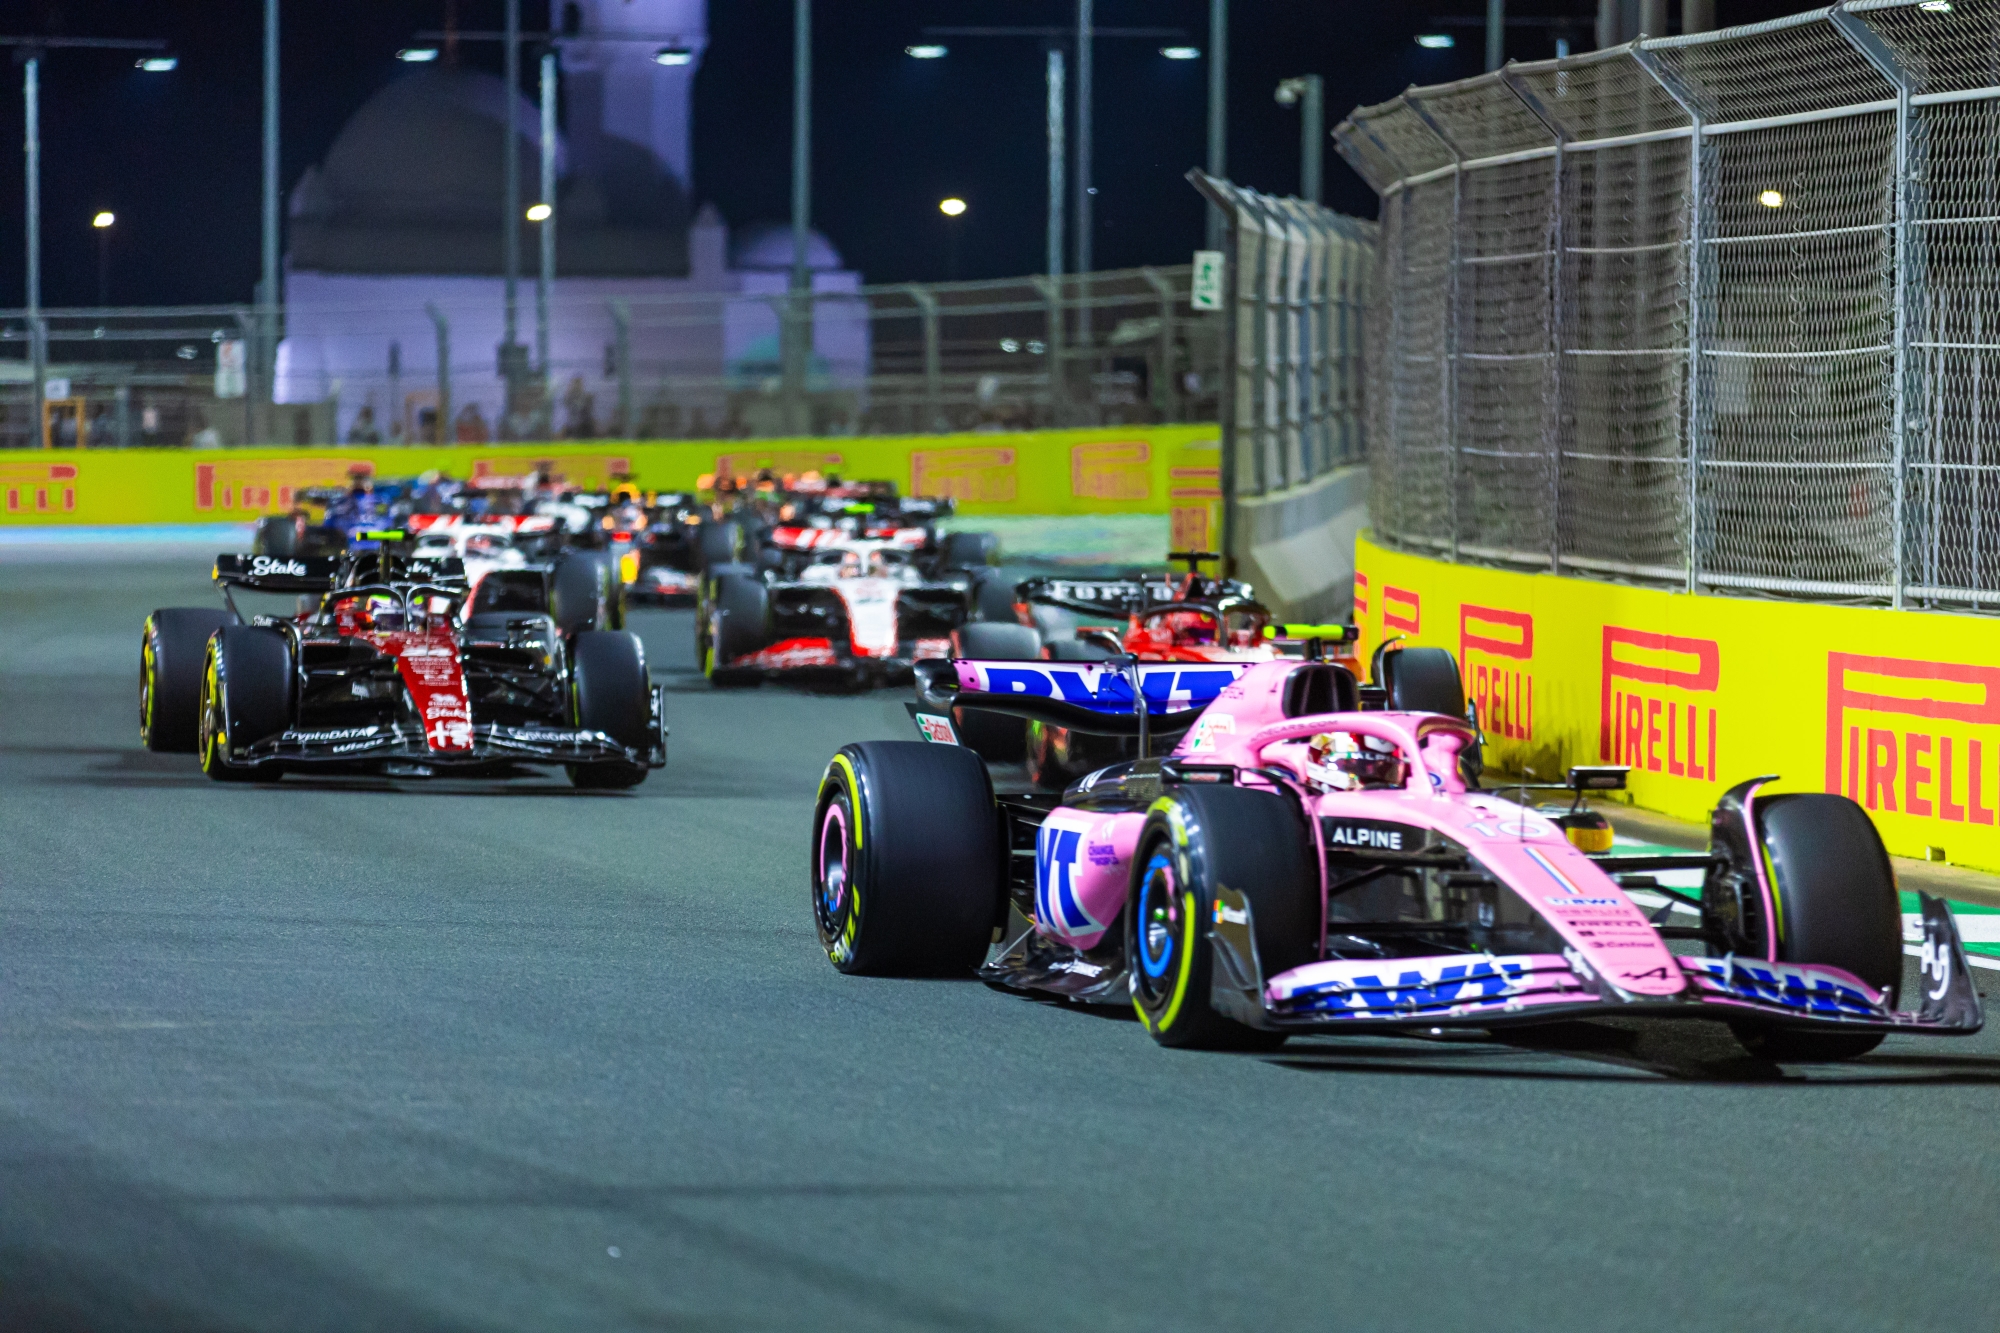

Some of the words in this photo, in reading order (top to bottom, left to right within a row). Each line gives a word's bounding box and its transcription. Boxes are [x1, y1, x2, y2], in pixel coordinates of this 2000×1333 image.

[253, 556, 307, 576] Stake
[1460, 603, 1534, 742] PIRELLI
[1601, 624, 1720, 782] PIRELLI
[282, 728, 366, 743] CryptoDATA
[1825, 651, 2000, 827] PIRELL
[1332, 827, 1402, 850] ALPINE
[1465, 820, 1550, 838] 10
